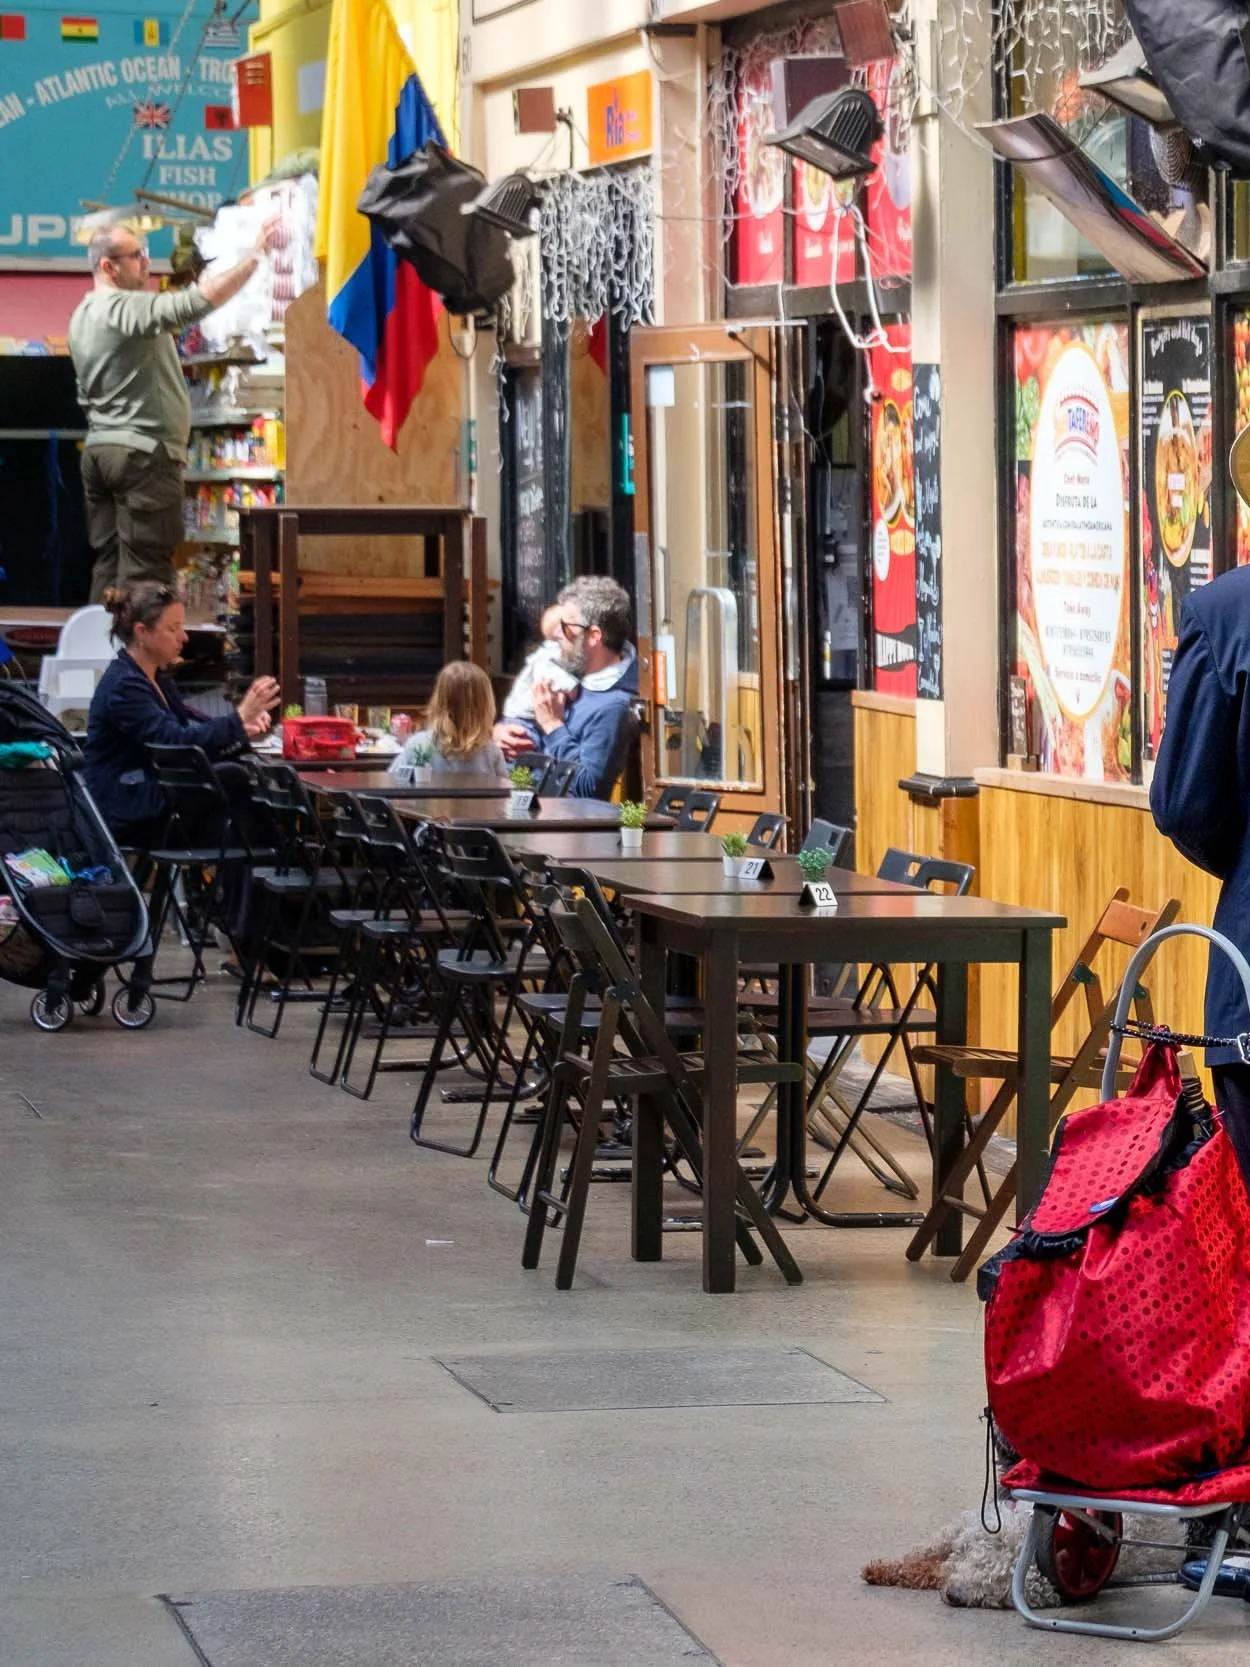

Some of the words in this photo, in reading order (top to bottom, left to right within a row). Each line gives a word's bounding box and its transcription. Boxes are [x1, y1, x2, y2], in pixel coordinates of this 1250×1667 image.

[35, 60, 118, 106] ATLANTIC
[121, 56, 181, 83] OCEAN
[142, 133, 232, 162] ILIAS
[160, 165, 216, 187] FISH
[744, 861, 759, 874] 21
[815, 887, 832, 901] 22
